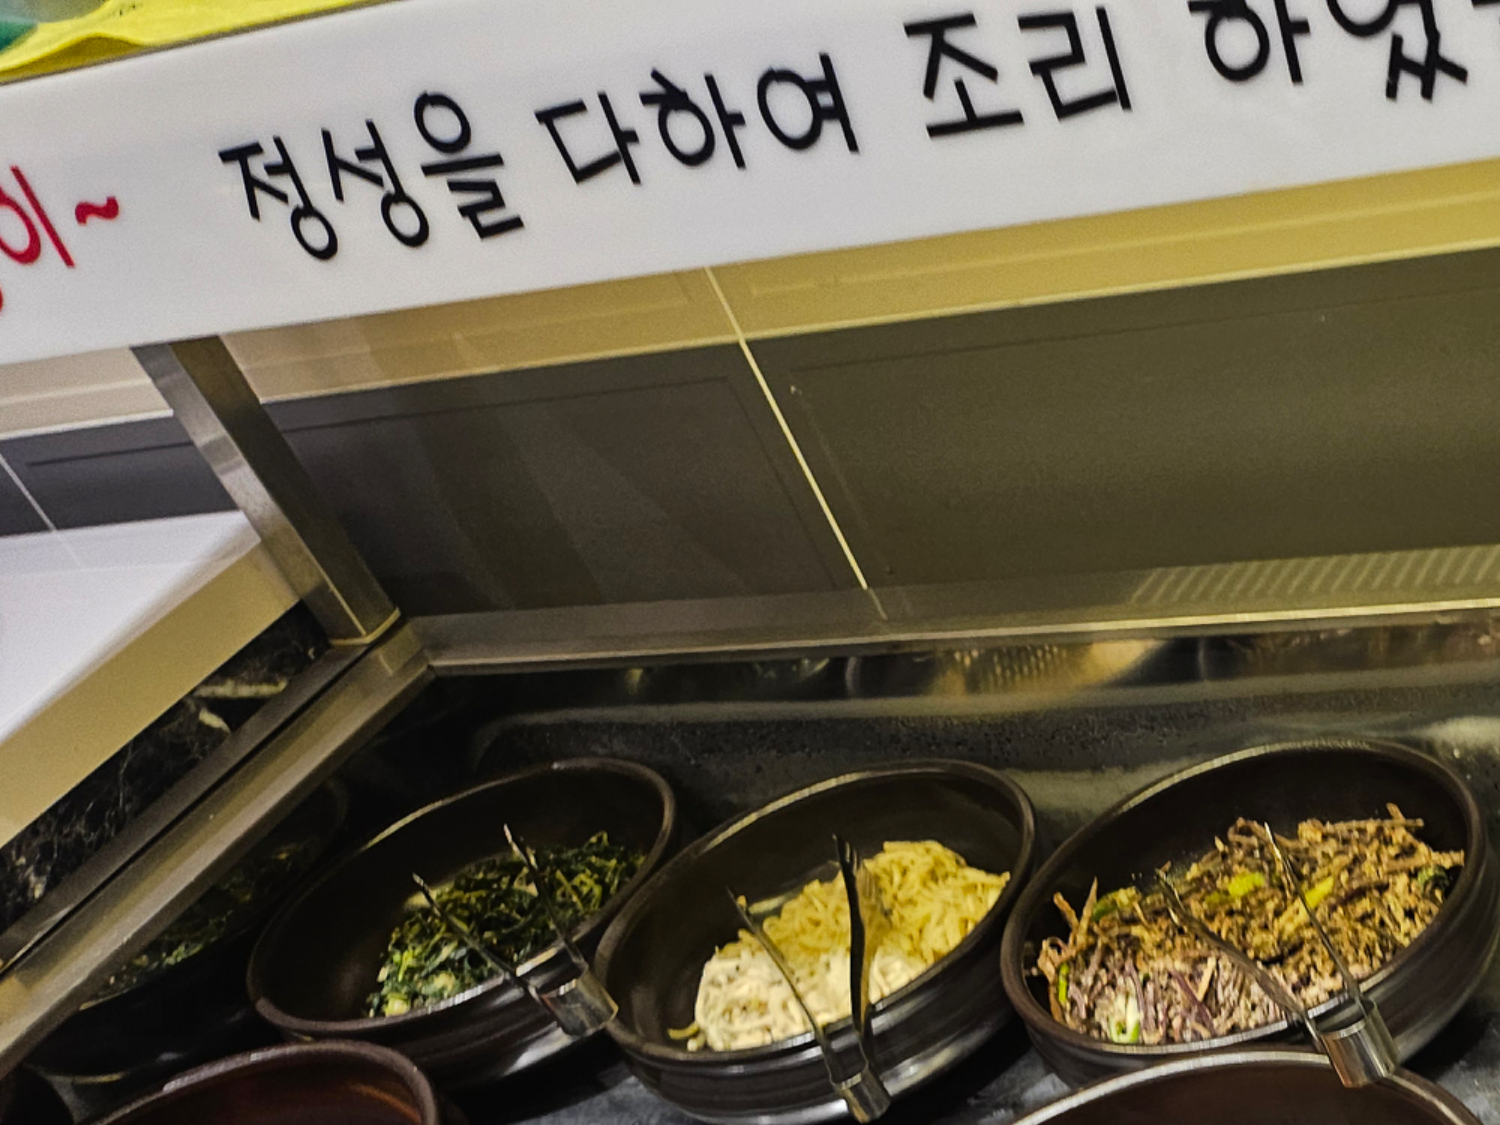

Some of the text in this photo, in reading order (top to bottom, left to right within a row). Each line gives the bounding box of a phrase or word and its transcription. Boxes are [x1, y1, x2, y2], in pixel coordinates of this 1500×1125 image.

[218, 91, 525, 262] 정성을
[534, 52, 860, 185] 다하여
[903, 6, 1132, 139] 조리
